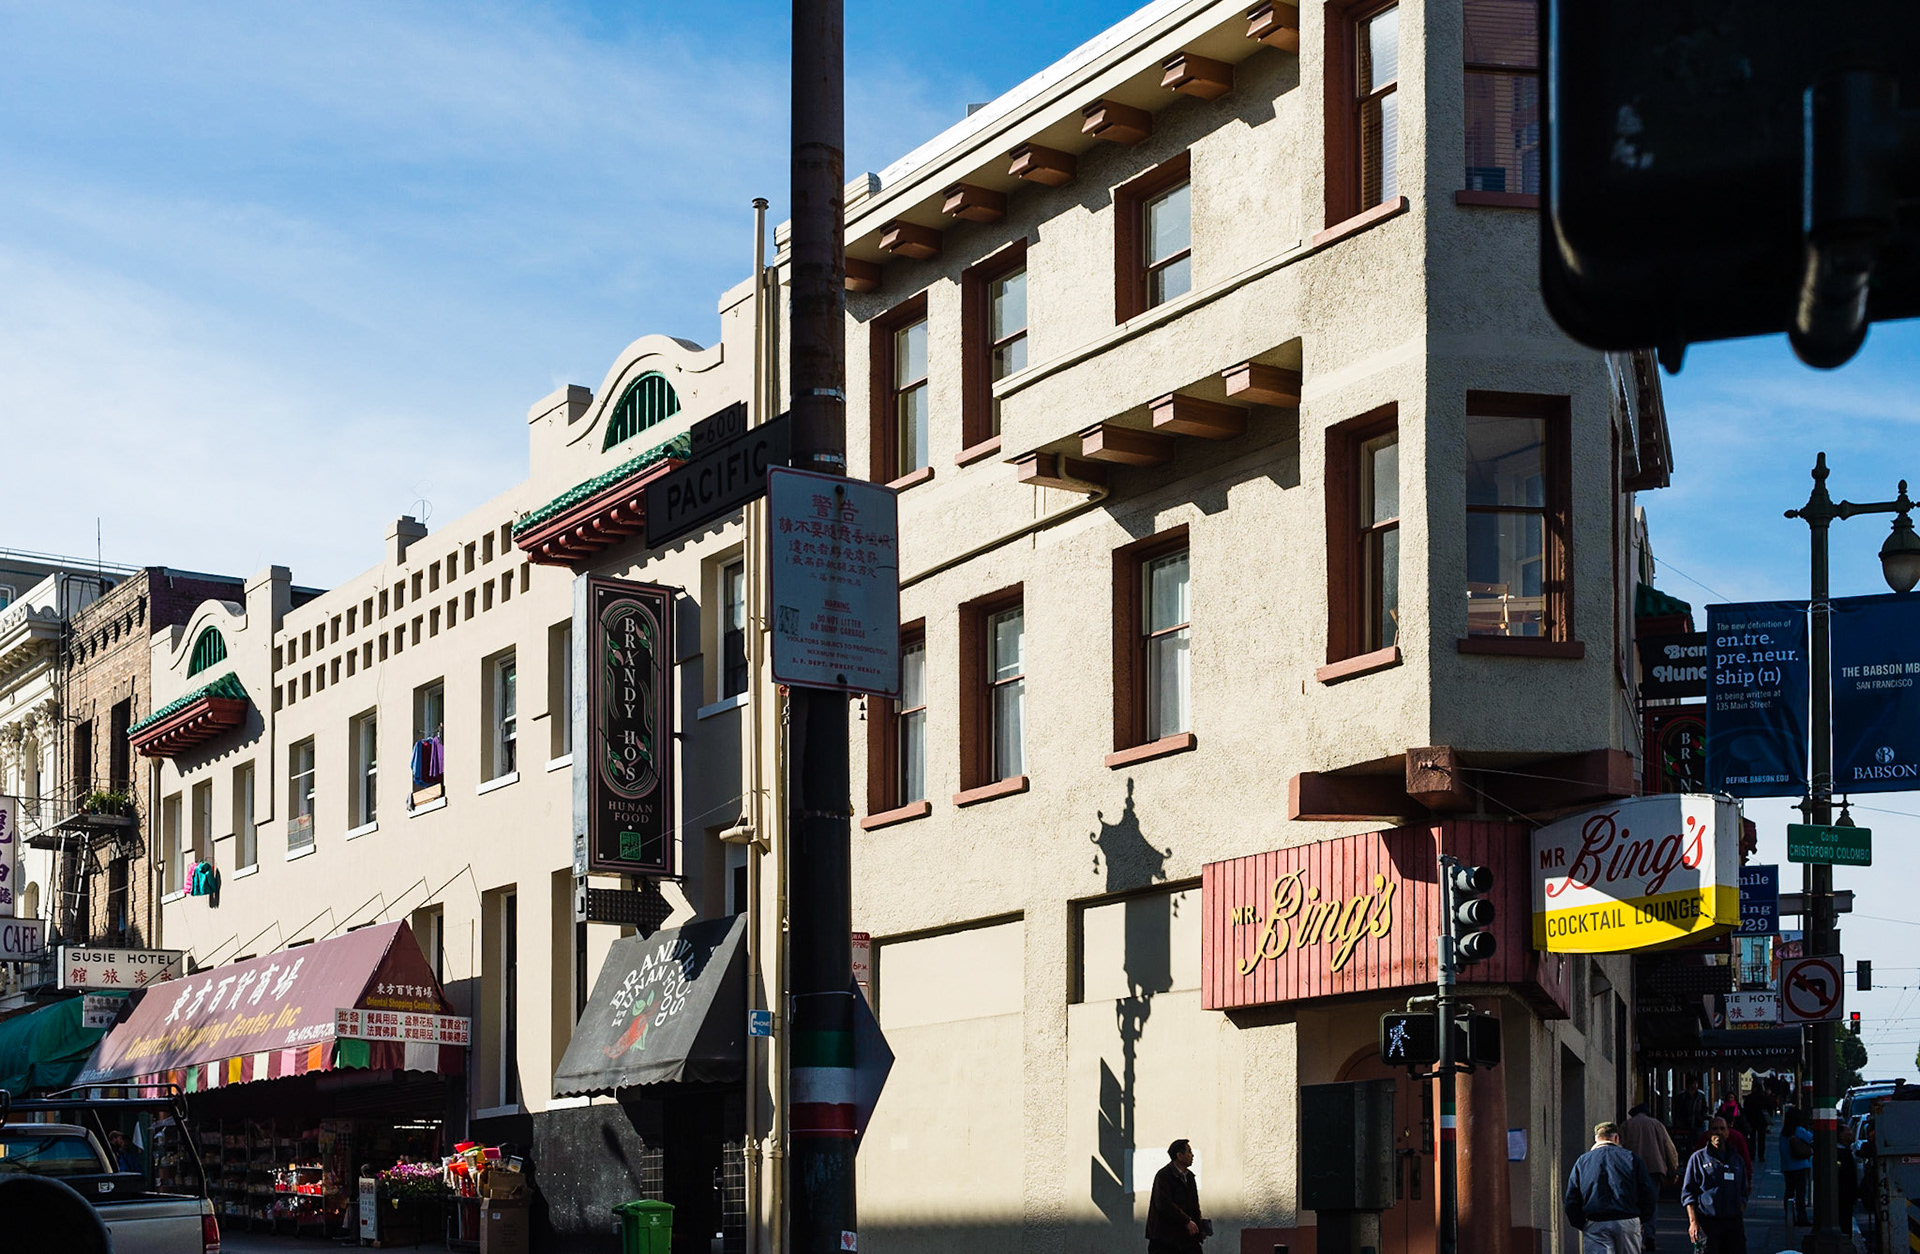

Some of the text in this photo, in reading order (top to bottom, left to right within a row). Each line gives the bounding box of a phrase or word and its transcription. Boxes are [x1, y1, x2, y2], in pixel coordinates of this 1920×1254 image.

[707, 410, 737, 444] 600
[667, 440, 768, 522] PACIFIC
[813, 494, 860, 523] 警告
[817, 615, 862, 628] DO NOT LITTER
[1717, 623, 1730, 631] The
[1748, 620, 1782, 630] definition
[1784, 619, 1791, 627] of
[810, 622, 866, 638] OR DUMP GARBAGE
[787, 636, 819, 646] VIOLATORS
[1716, 633, 1775, 648] en.tre.
[1664, 645, 1707, 659] Bran
[1716, 649, 1799, 669] pre.neur.
[624, 618, 636, 719] BRANDY
[830, 662, 854, 670] PUBLIC
[858, 667, 881, 675] HEALTH
[1842, 662, 1920, 677] THE BABSON MB
[1716, 666, 1782, 687] ship (n)
[1856, 678, 1913, 690] SAN FRANCISCO
[1716, 693, 1723, 701] is
[1725, 692, 1744, 701] being
[1746, 690, 1771, 699] written
[1717, 703, 1729, 711] 135
[1730, 702, 1748, 710] Main
[1681, 732, 1692, 792] BRAN
[1854, 764, 1918, 780] BABSON
[608, 801, 653, 813] HUNAN
[614, 812, 649, 823] FOOD
[1820, 831, 1839, 842] Corso
[1539, 810, 1706, 898] MR Bing's
[1836, 847, 1870, 860] COLOMBO
[1231, 867, 1397, 975] MR. Bing's
[1547, 895, 1702, 938] COCKTAIL LOUNGE
[3, 925, 38, 953] CAFE
[71, 952, 174, 965] SUSIE HOTEL
[610, 938, 693, 1010] BRANDY
[165, 957, 305, 1025] 東方百貨商場
[376, 983, 433, 998] 東方百貨商場
[612, 964, 667, 1028] HUNAN
[366, 997, 388, 1007] Oriental
[388, 998, 413, 1010] Shopping
[1725, 995, 1779, 1003] SIE HOTE
[1637, 1004, 1683, 1013] COCKTAILS
[338, 1011, 359, 1023] 批發
[367, 1013, 398, 1025] 餐具用品
[125, 1003, 302, 1061] Oriental Shopping Center, Inc
[338, 1023, 359, 1036] 零售
[404, 1028, 433, 1040] 家庭用品
[1648, 1048, 1689, 1058] BRANDY
[1724, 1047, 1763, 1056] HUNAN
[1765, 1047, 1795, 1056] FOOD
